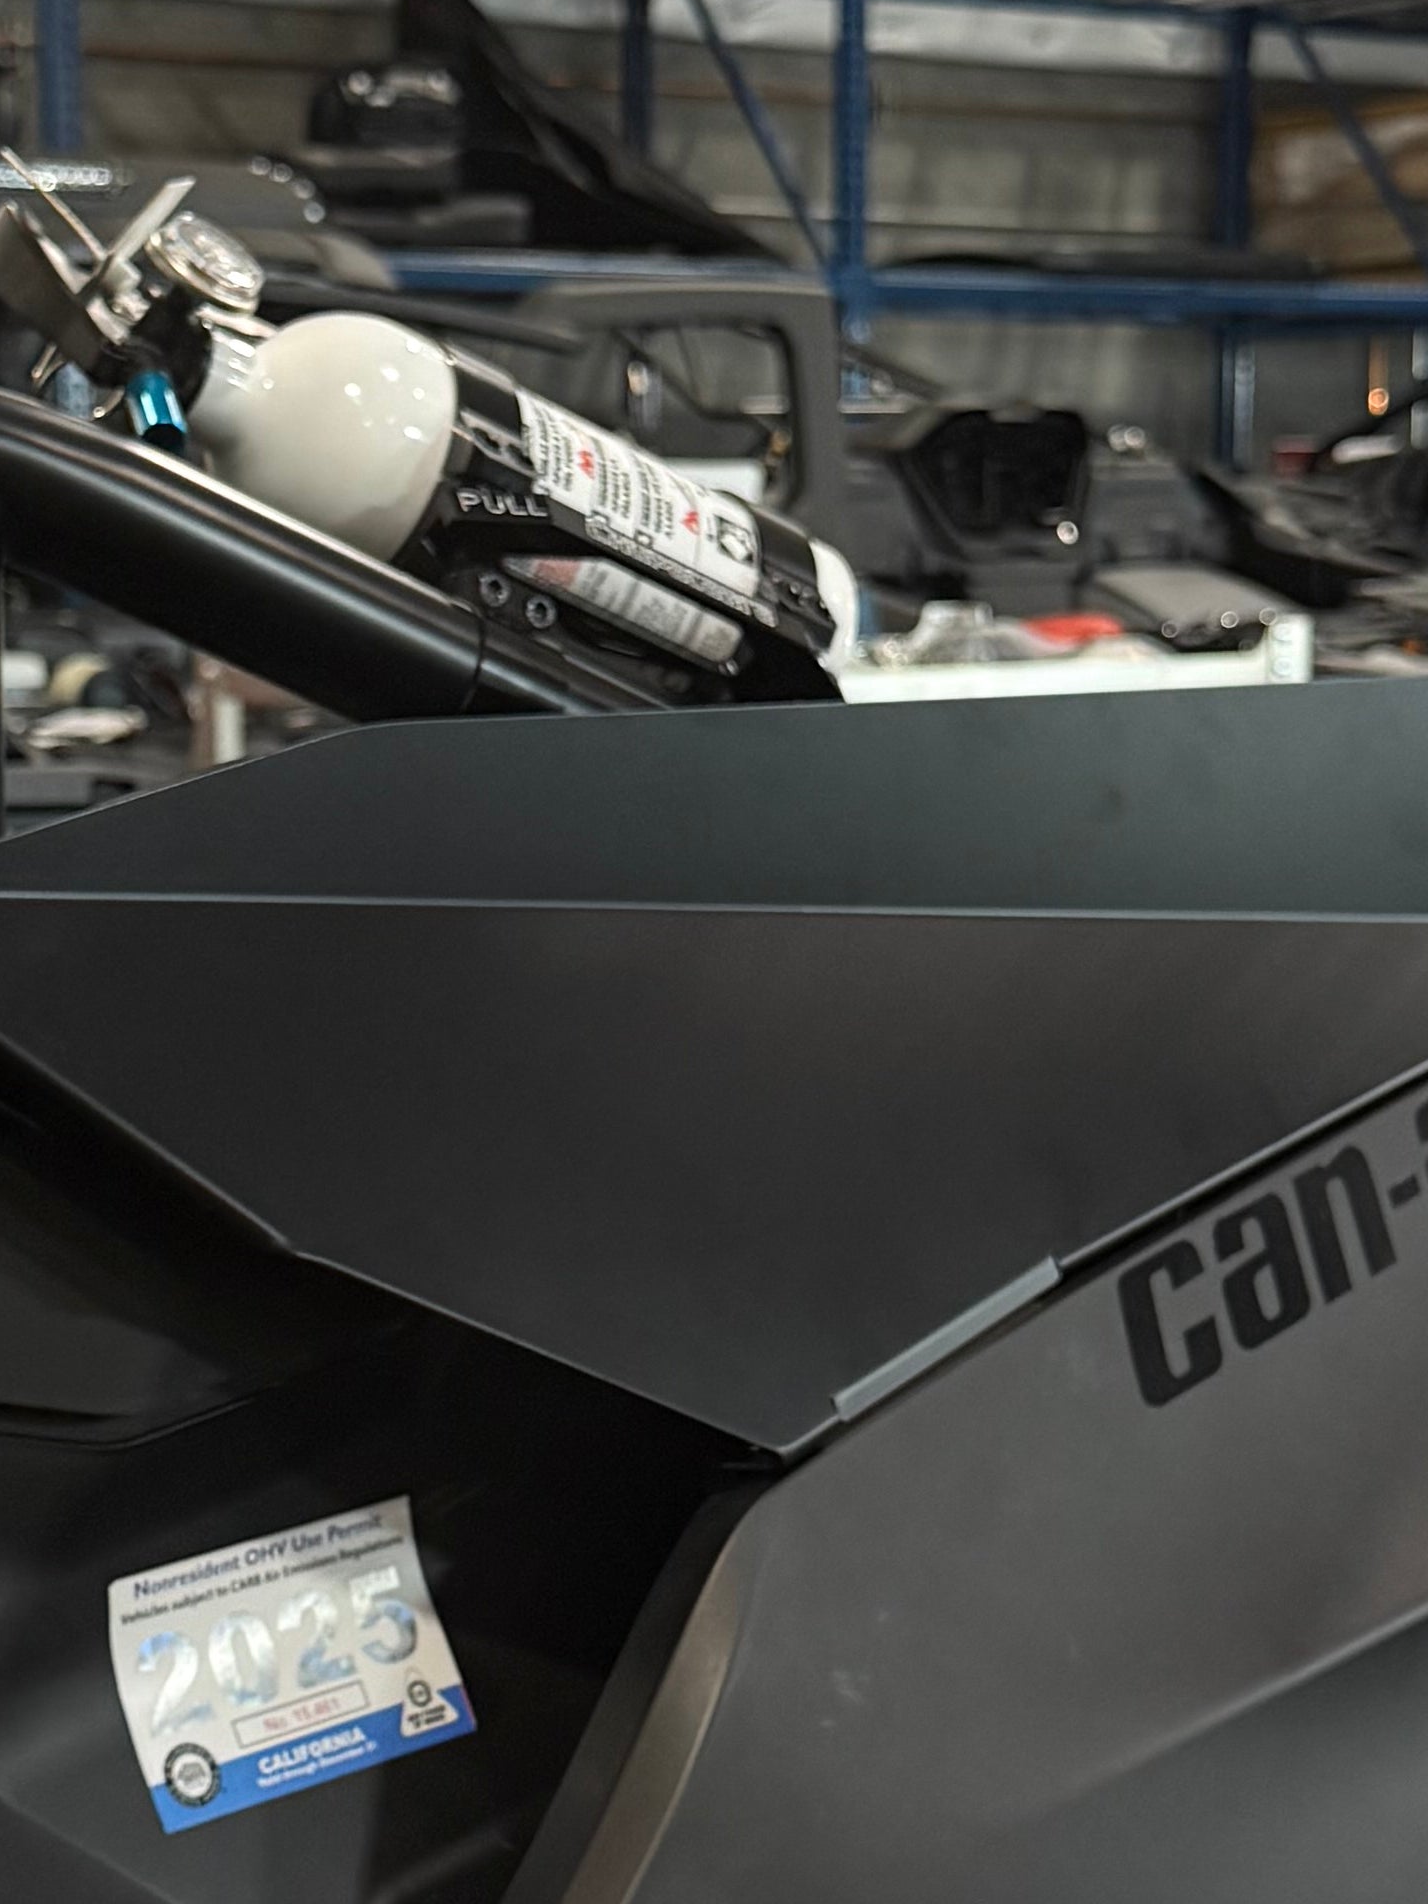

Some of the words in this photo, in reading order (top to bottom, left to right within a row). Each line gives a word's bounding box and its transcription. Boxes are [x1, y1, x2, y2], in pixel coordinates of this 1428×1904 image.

[456, 487, 548, 517] PULL
[134, 1555, 240, 1600] Nonresident
[245, 1539, 289, 1566] OHV
[291, 1533, 322, 1553] Use
[327, 1513, 382, 1543] Permit
[137, 1565, 419, 1738] 2025
[257, 1725, 367, 1775] CALIFORNIA
